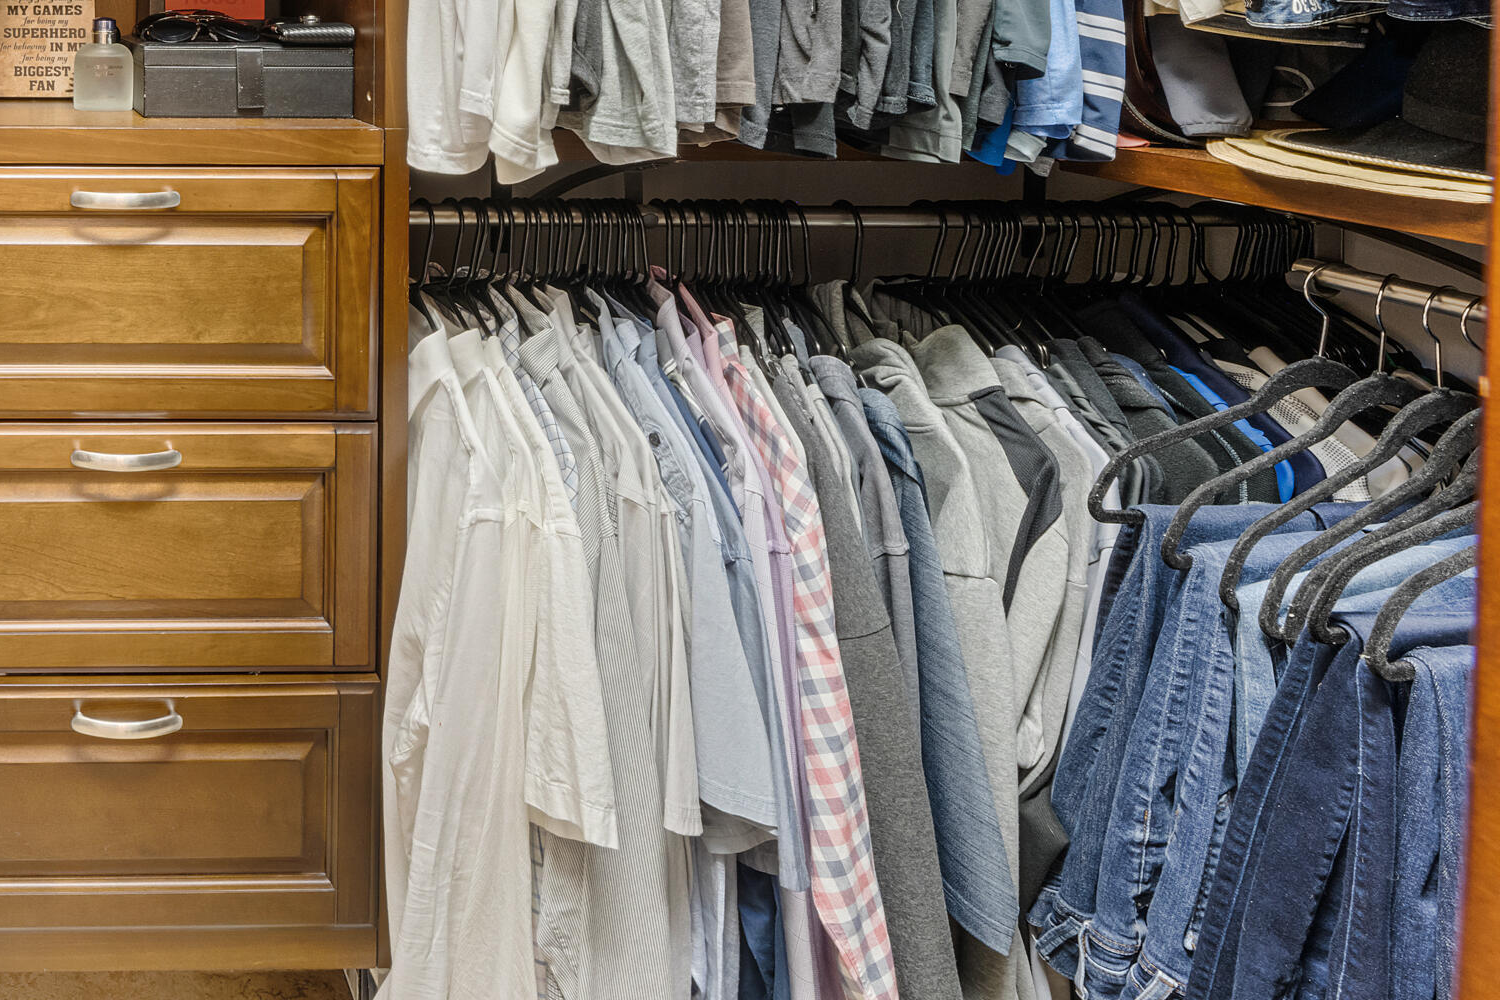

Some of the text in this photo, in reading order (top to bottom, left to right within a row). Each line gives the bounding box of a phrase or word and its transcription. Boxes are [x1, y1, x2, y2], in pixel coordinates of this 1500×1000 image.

[7, 5, 83, 15] MY GAMES
[20, 16, 69, 27] for being my
[3, 28, 86, 39] SUPERHERO
[13, 41, 47, 52] believing
[50, 42, 63, 52] IN
[19, 53, 68, 64] for being my
[14, 65, 71, 77] BIGGEST
[29, 80, 56, 91] FAN
